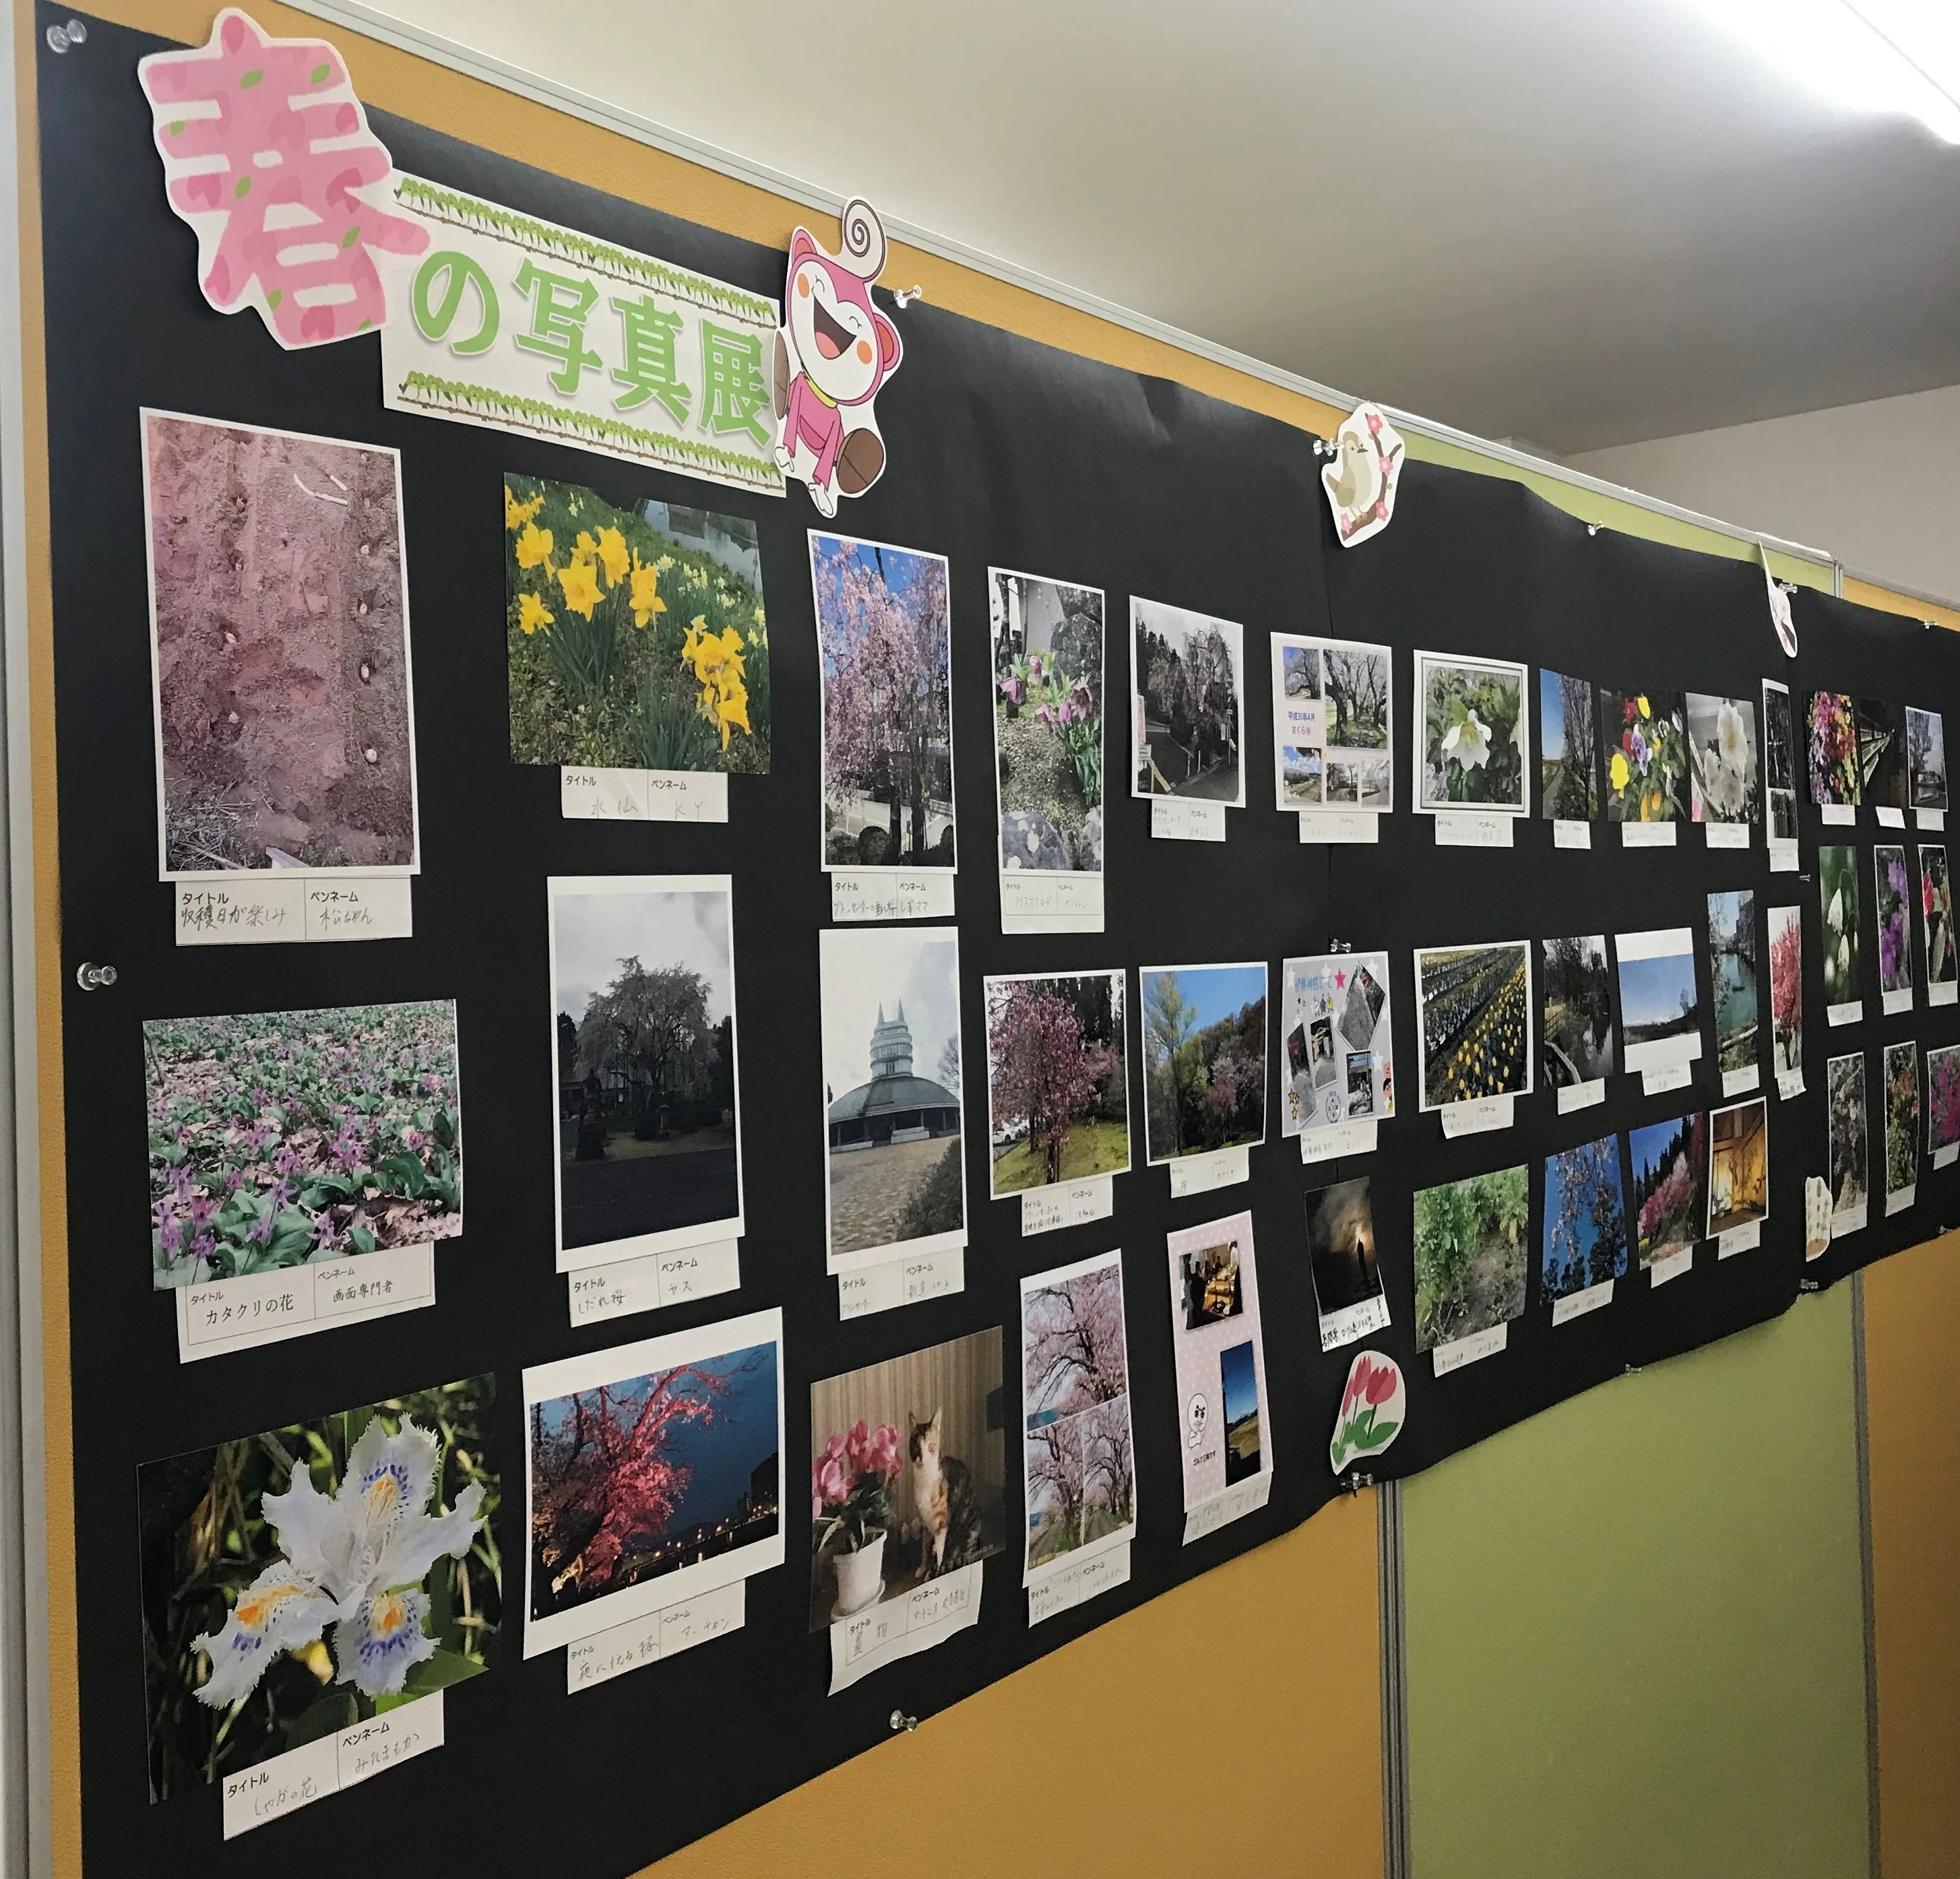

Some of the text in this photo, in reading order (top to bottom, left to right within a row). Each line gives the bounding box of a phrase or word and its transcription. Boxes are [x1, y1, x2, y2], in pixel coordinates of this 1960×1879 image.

[145, 15, 772, 447] 春の写真展
[565, 775, 597, 786] タイトル
[651, 779, 687, 790] ペンネーム
[835, 882, 859, 891] タイトル
[899, 883, 926, 891] ペンネーム
[182, 893, 229, 905] タイトル
[311, 891, 358, 903] ペンネーム
[661, 1258, 698, 1273] ペンネーム
[317, 1267, 356, 1279] ペンネーム
[573, 1277, 606, 1293] タイトル
[190, 1291, 224, 1305] タイトル
[206, 1294, 294, 1327] カタクリの花
[342, 1722, 390, 1747] ペンネーム
[228, 1773, 270, 1798] タイトル
